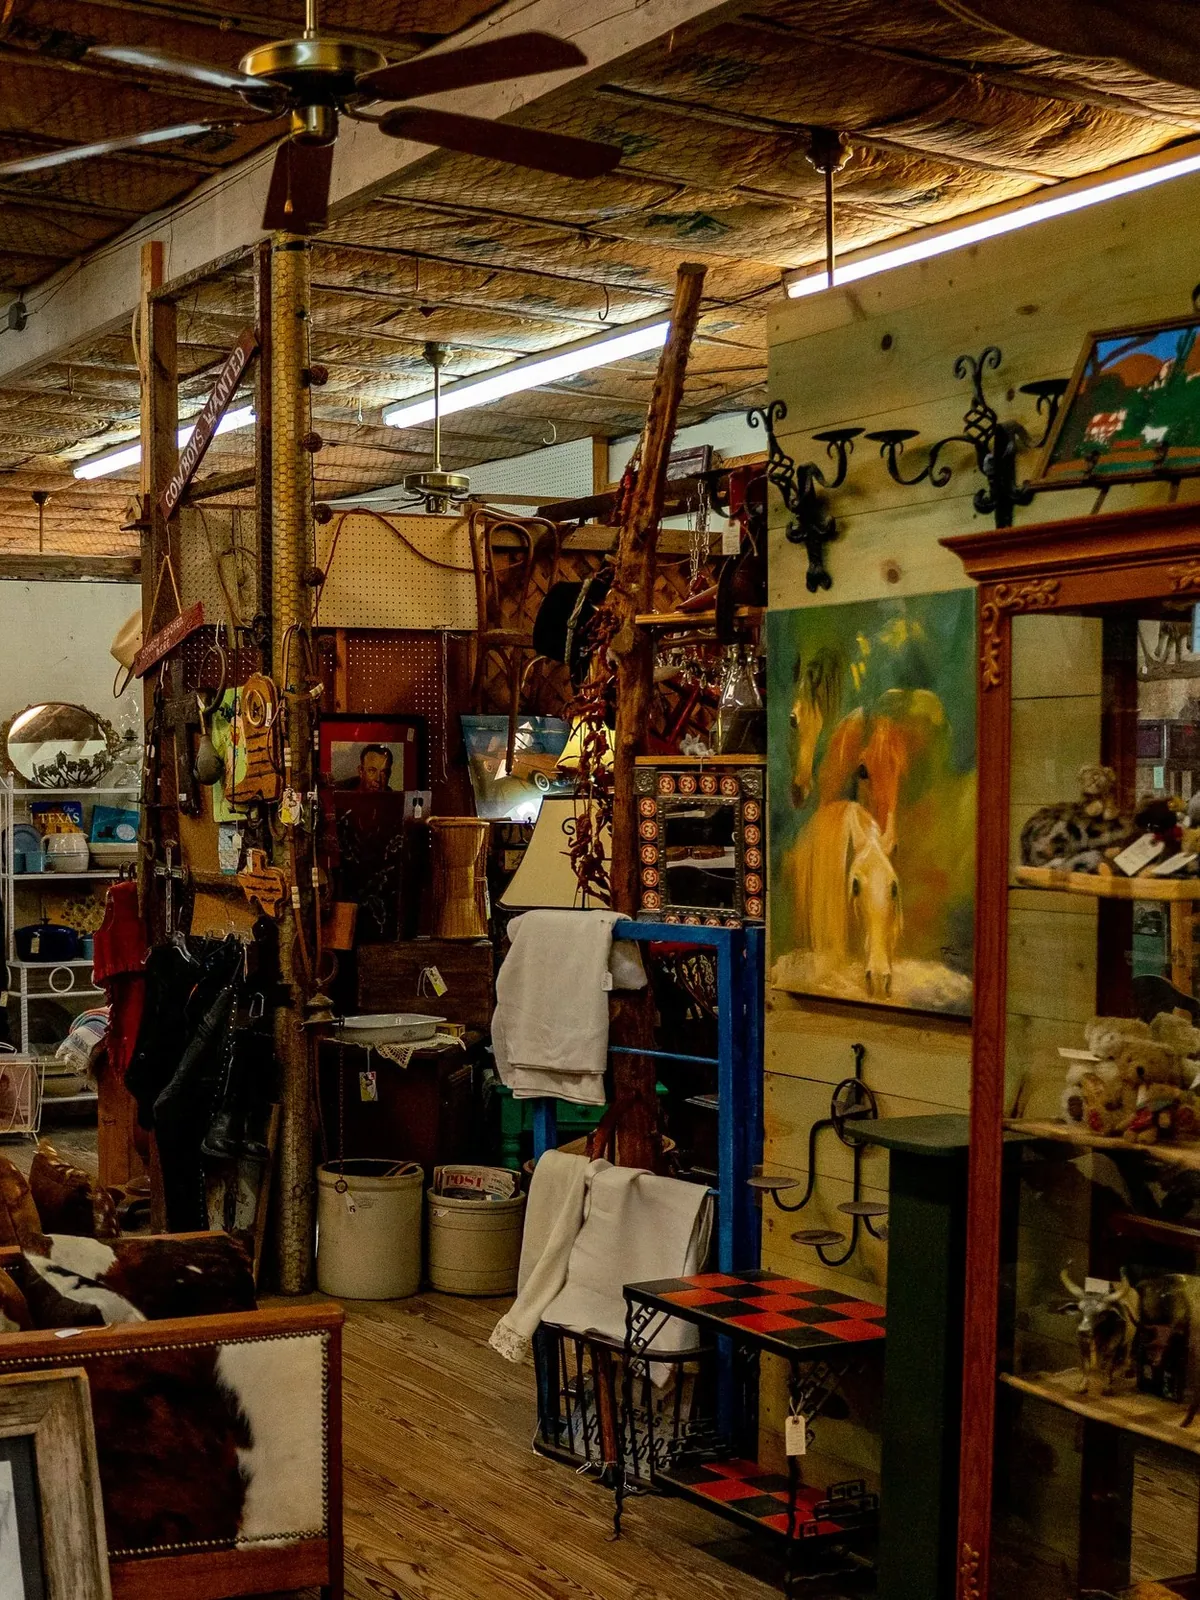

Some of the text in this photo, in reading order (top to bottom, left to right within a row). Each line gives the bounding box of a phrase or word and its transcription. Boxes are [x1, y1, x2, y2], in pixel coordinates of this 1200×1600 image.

[164, 346, 246, 508] COWBOYS WANTED
[62, 805, 76, 813] Our
[38, 812, 80, 824] TEXAS
[446, 1173, 483, 1188] POST
